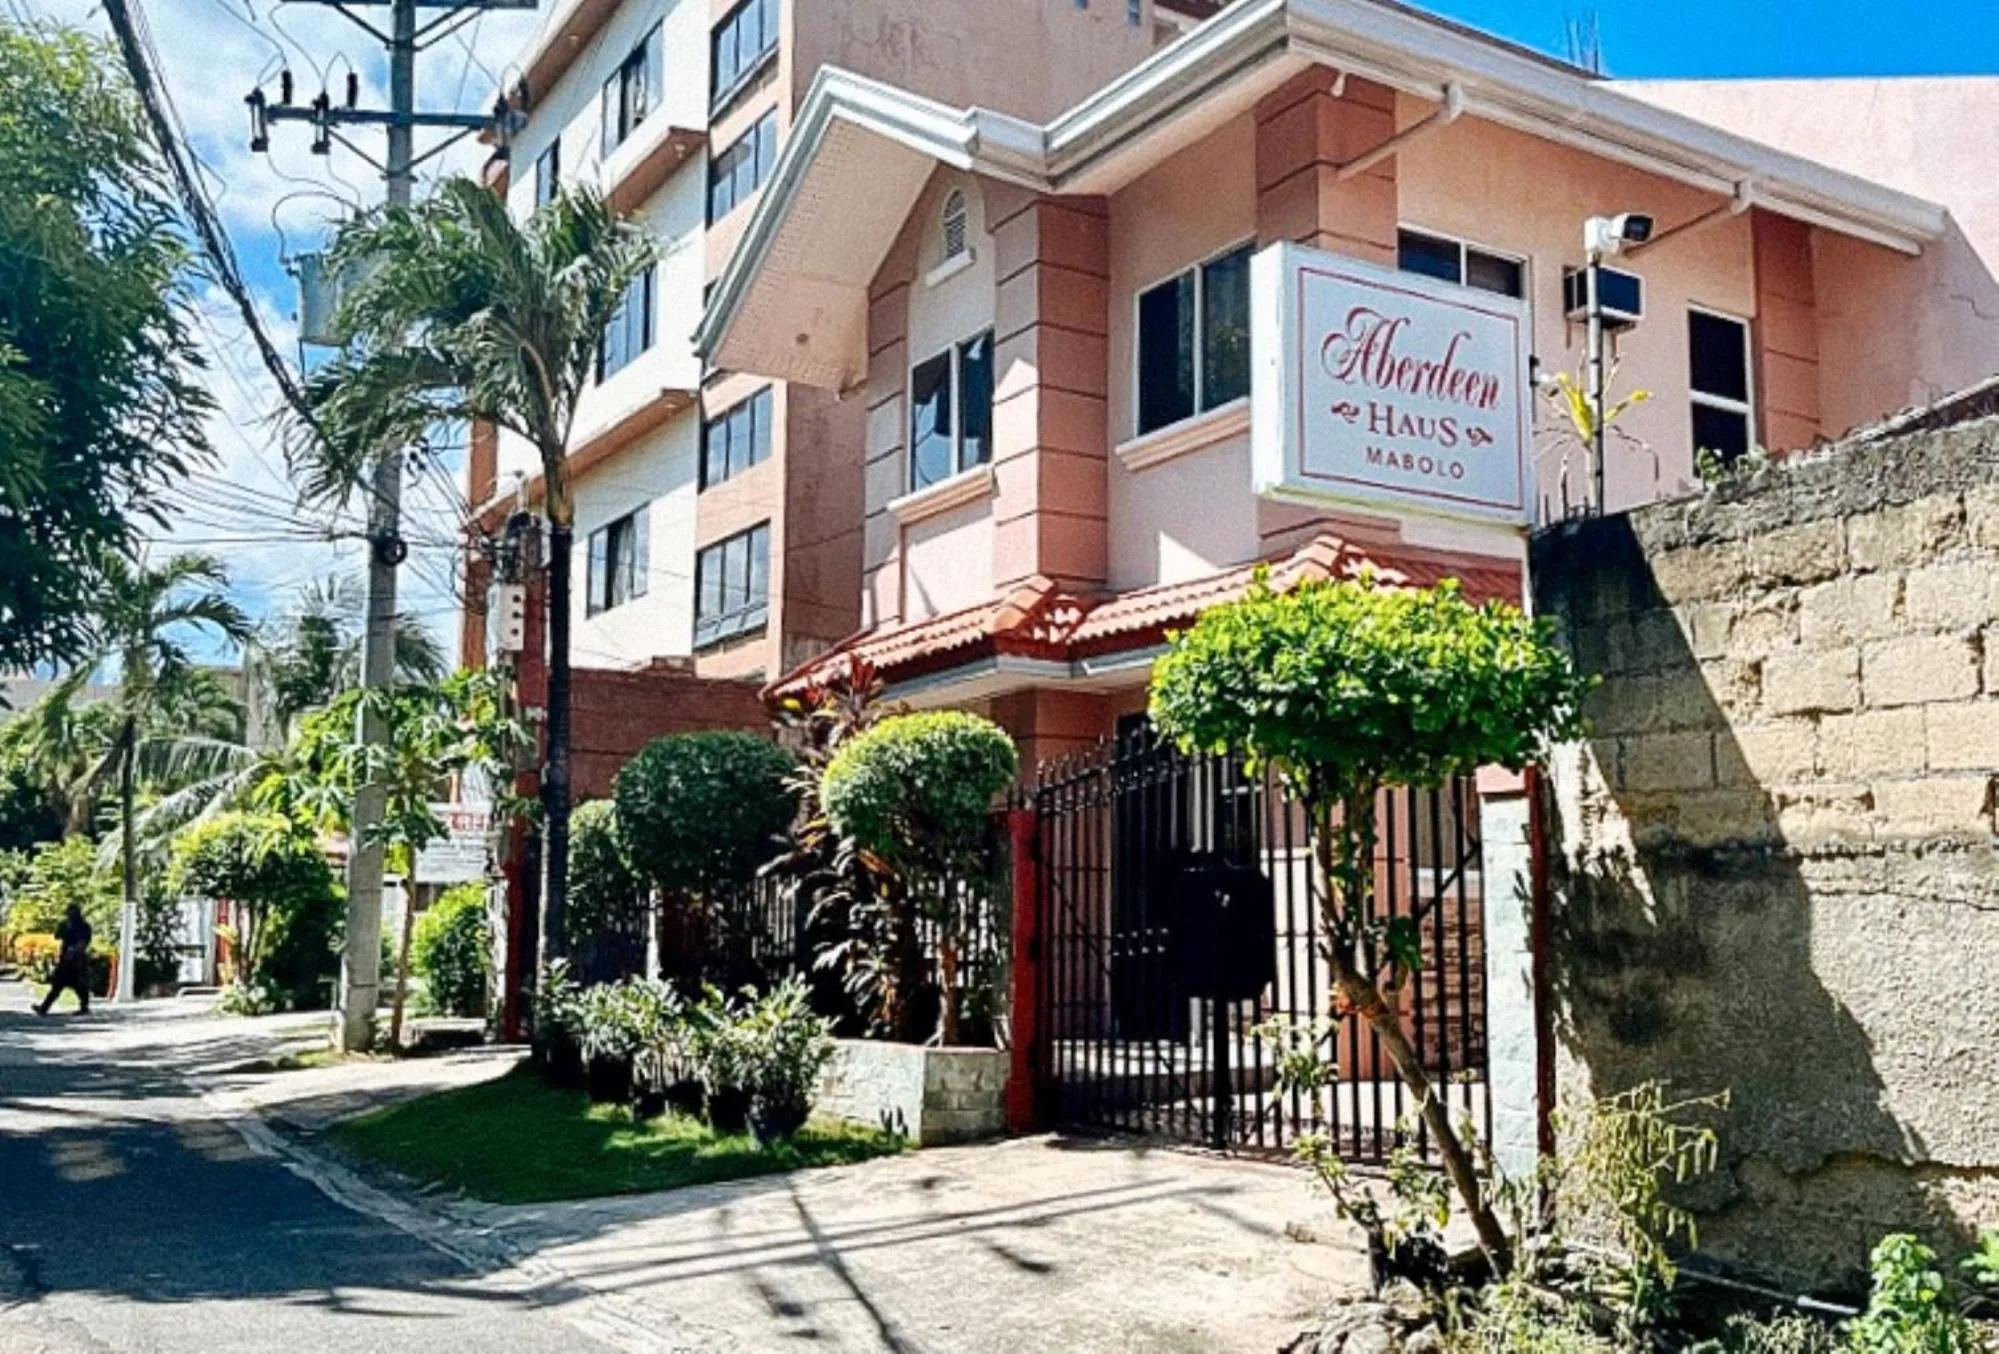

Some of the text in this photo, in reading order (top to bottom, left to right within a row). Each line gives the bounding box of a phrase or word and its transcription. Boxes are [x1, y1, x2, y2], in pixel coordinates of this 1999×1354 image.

[1321, 307, 1498, 409] Aberdeen
[1368, 401, 1459, 447] HAUS
[1366, 447, 1464, 479] MABOLO
